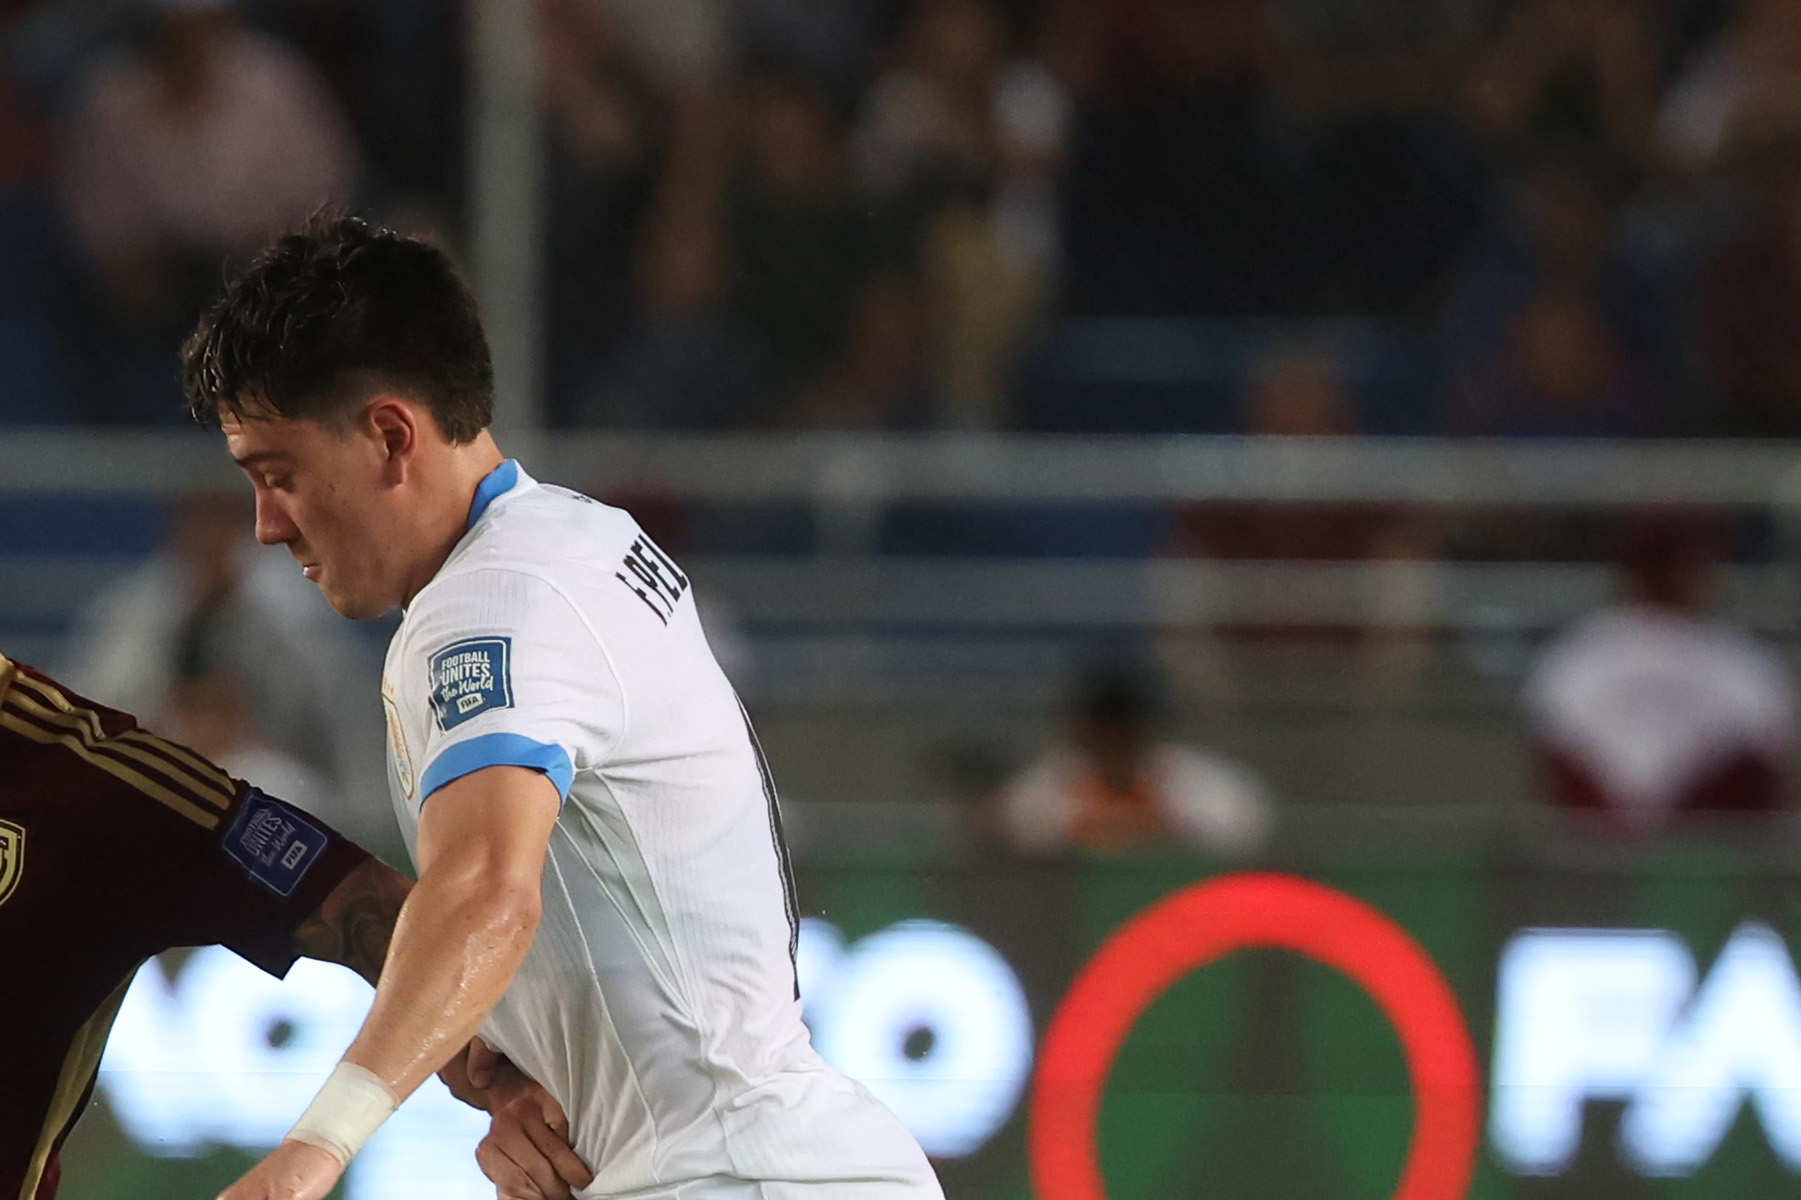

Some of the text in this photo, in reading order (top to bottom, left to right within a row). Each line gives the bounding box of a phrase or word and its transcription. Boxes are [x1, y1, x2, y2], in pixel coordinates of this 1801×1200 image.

[441, 650, 491, 671] FOOTBALL
[440, 662, 491, 686] UNITES
[441, 675, 494, 702] the World
[460, 696, 480, 709] FIFA
[245, 815, 283, 857] UNITES
